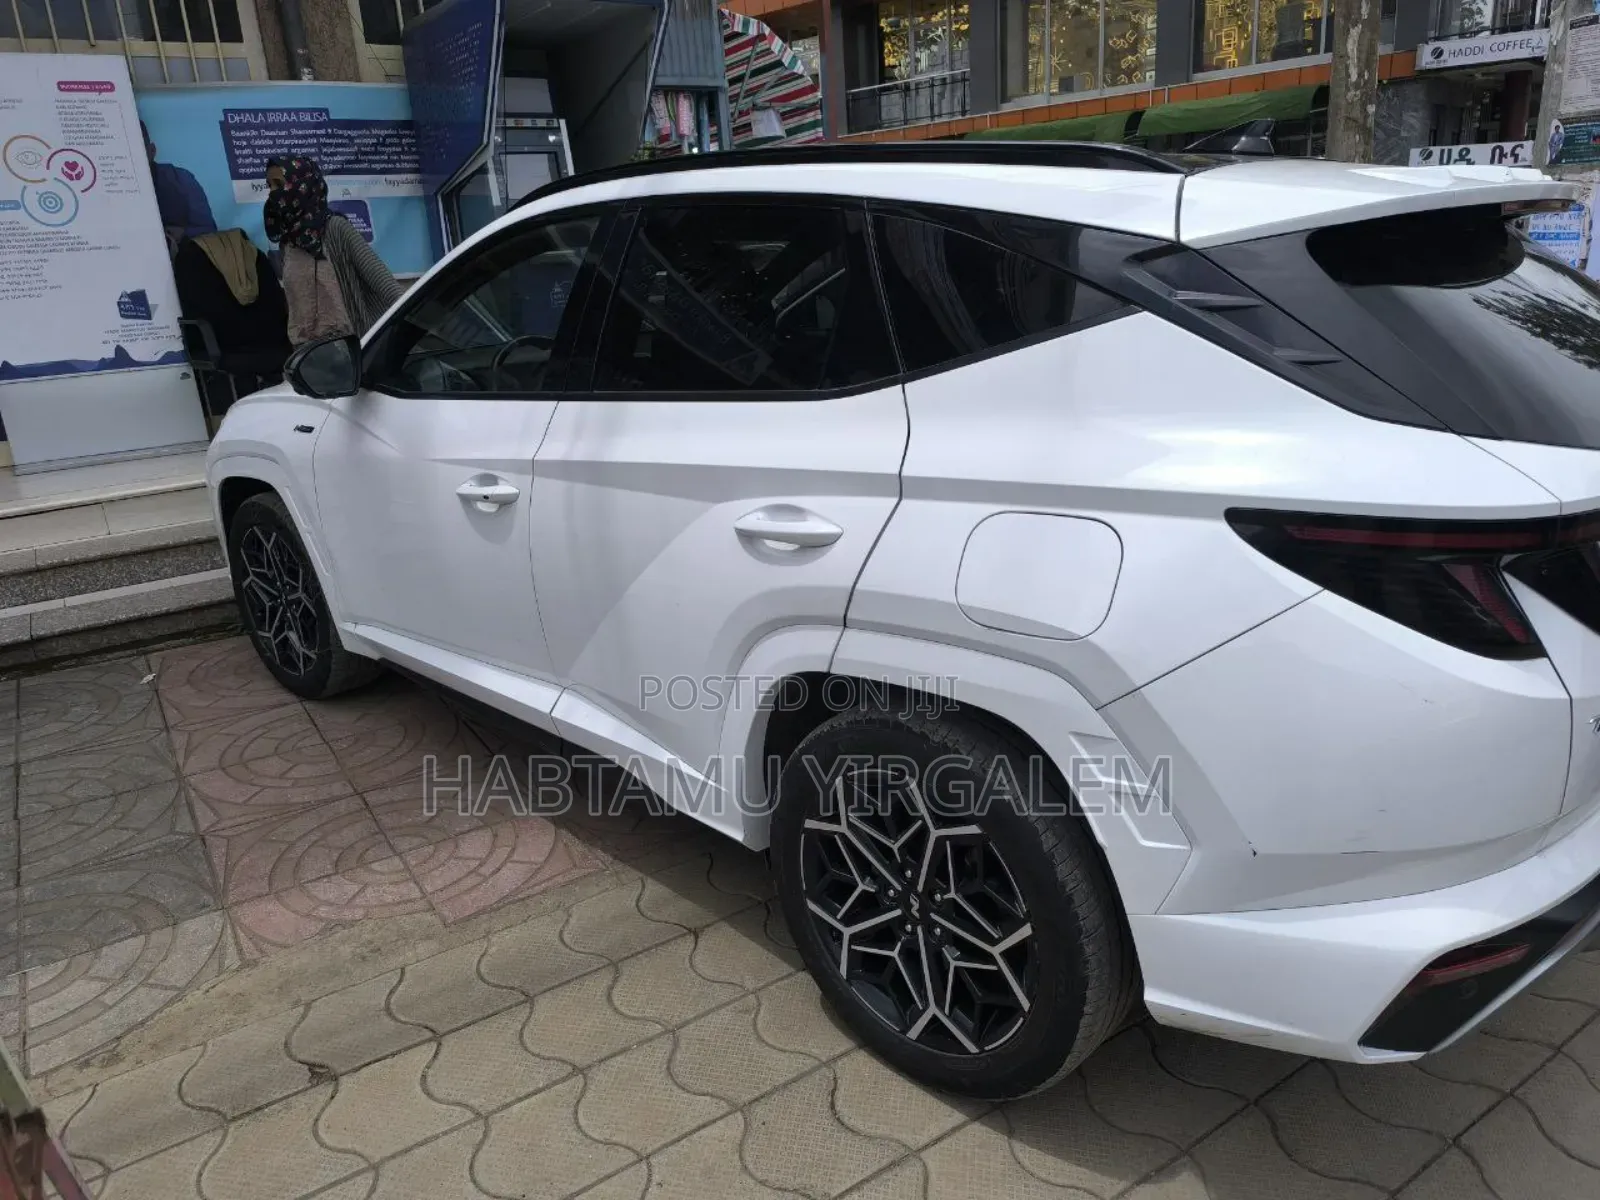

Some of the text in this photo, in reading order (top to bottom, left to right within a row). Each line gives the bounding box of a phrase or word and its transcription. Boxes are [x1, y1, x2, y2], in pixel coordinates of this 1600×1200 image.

[1448, 45, 1484, 58] HADDI
[1489, 38, 1532, 53] COFFEE
[227, 112, 265, 123] DHALA
[266, 111, 297, 122] IRRAA
[1490, 144, 1525, 165] ቡና
